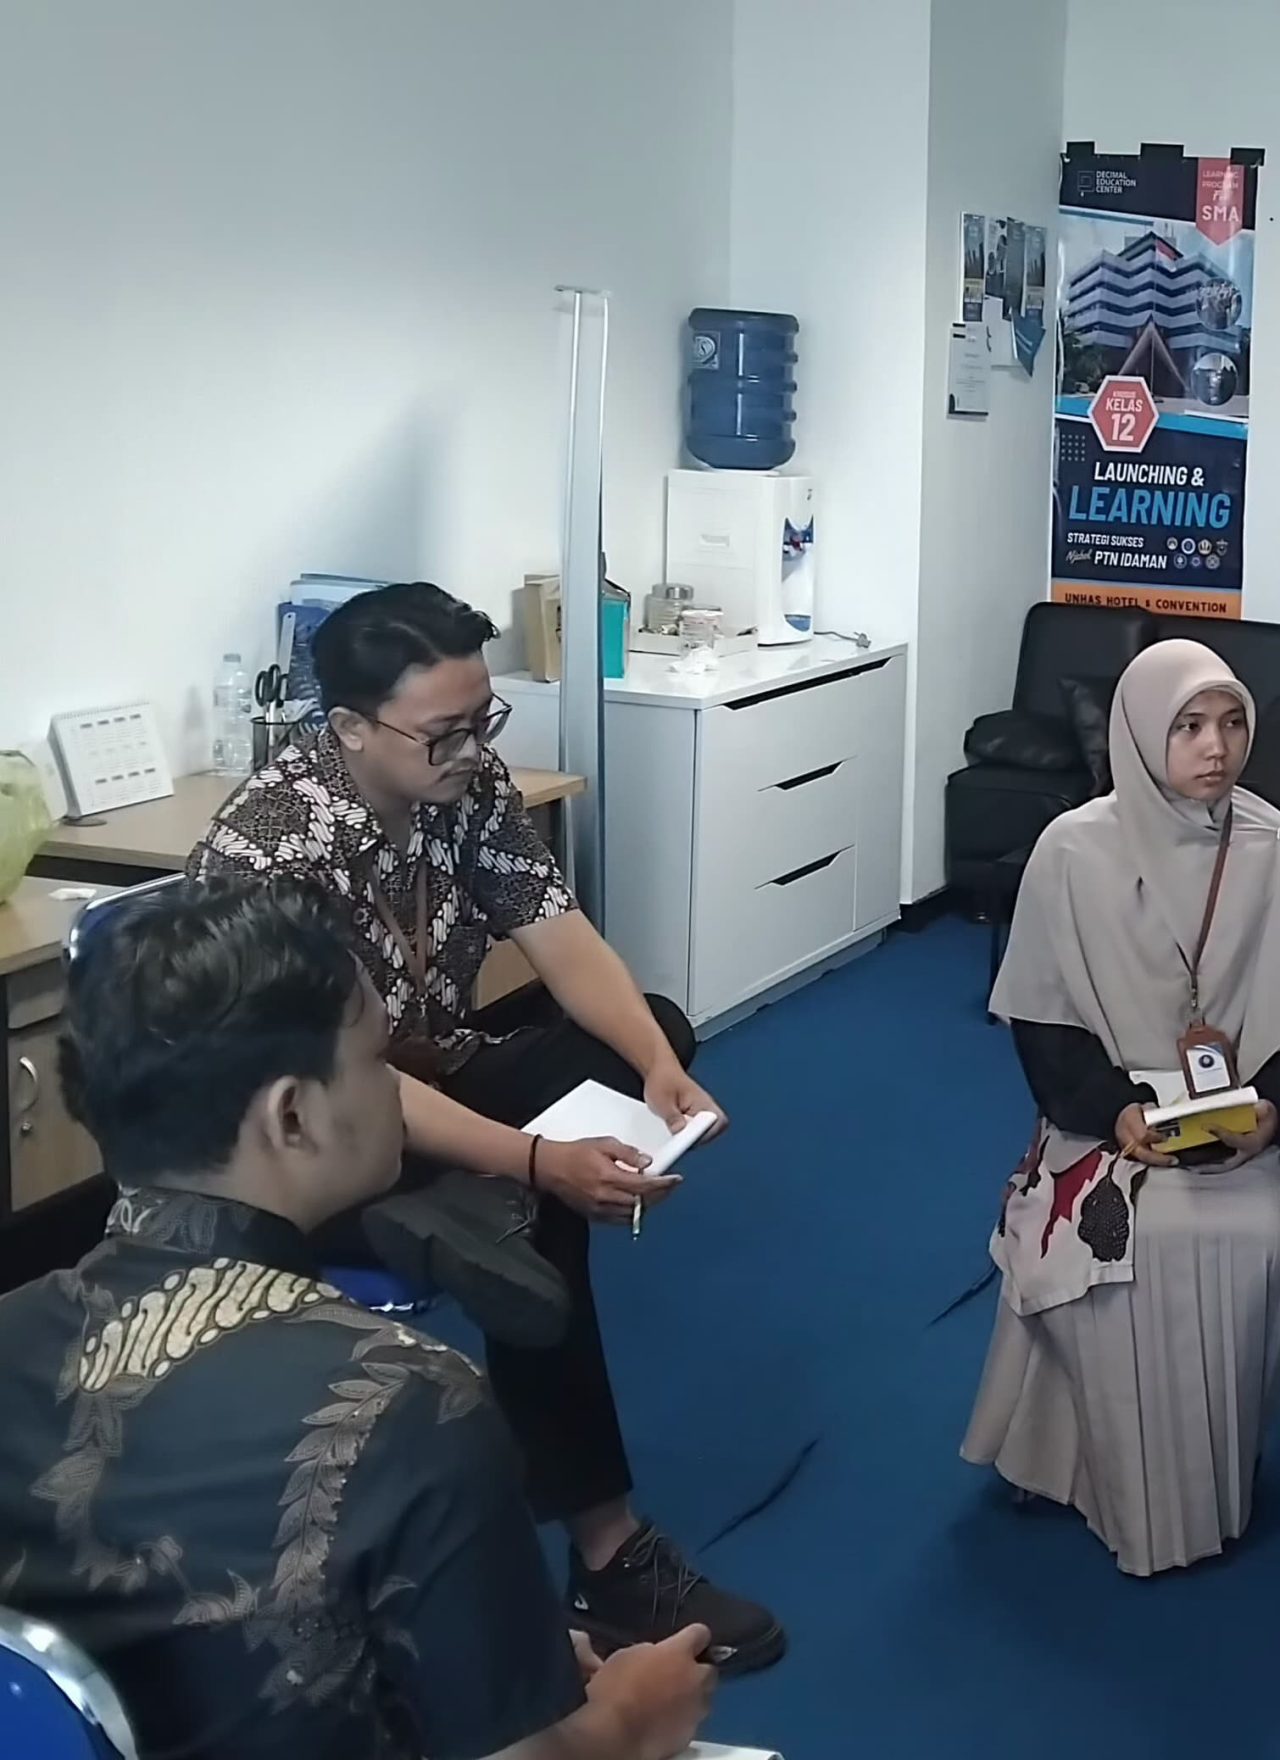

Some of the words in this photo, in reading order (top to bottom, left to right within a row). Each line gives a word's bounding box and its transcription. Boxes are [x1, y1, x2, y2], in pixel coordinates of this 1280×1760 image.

[1096, 171, 1127, 179] DECIMAL
[1096, 178, 1136, 186] EDUCATION
[1202, 205, 1239, 222] SMA
[1106, 398, 1143, 412] KELAS
[1111, 413, 1136, 441] 12
[1094, 462, 1188, 485] LAUNCHING
[1191, 467, 1205, 486] &
[1068, 485, 1231, 529] LEARNING
[1067, 533, 1110, 545] STRATEGI
[1111, 535, 1144, 548] SUKSES
[1094, 551, 1118, 566] PTN
[1120, 552, 1167, 569] IDAMAN
[1065, 593, 1102, 604] UNHAS
[1156, 599, 1226, 613] CONVENTION
